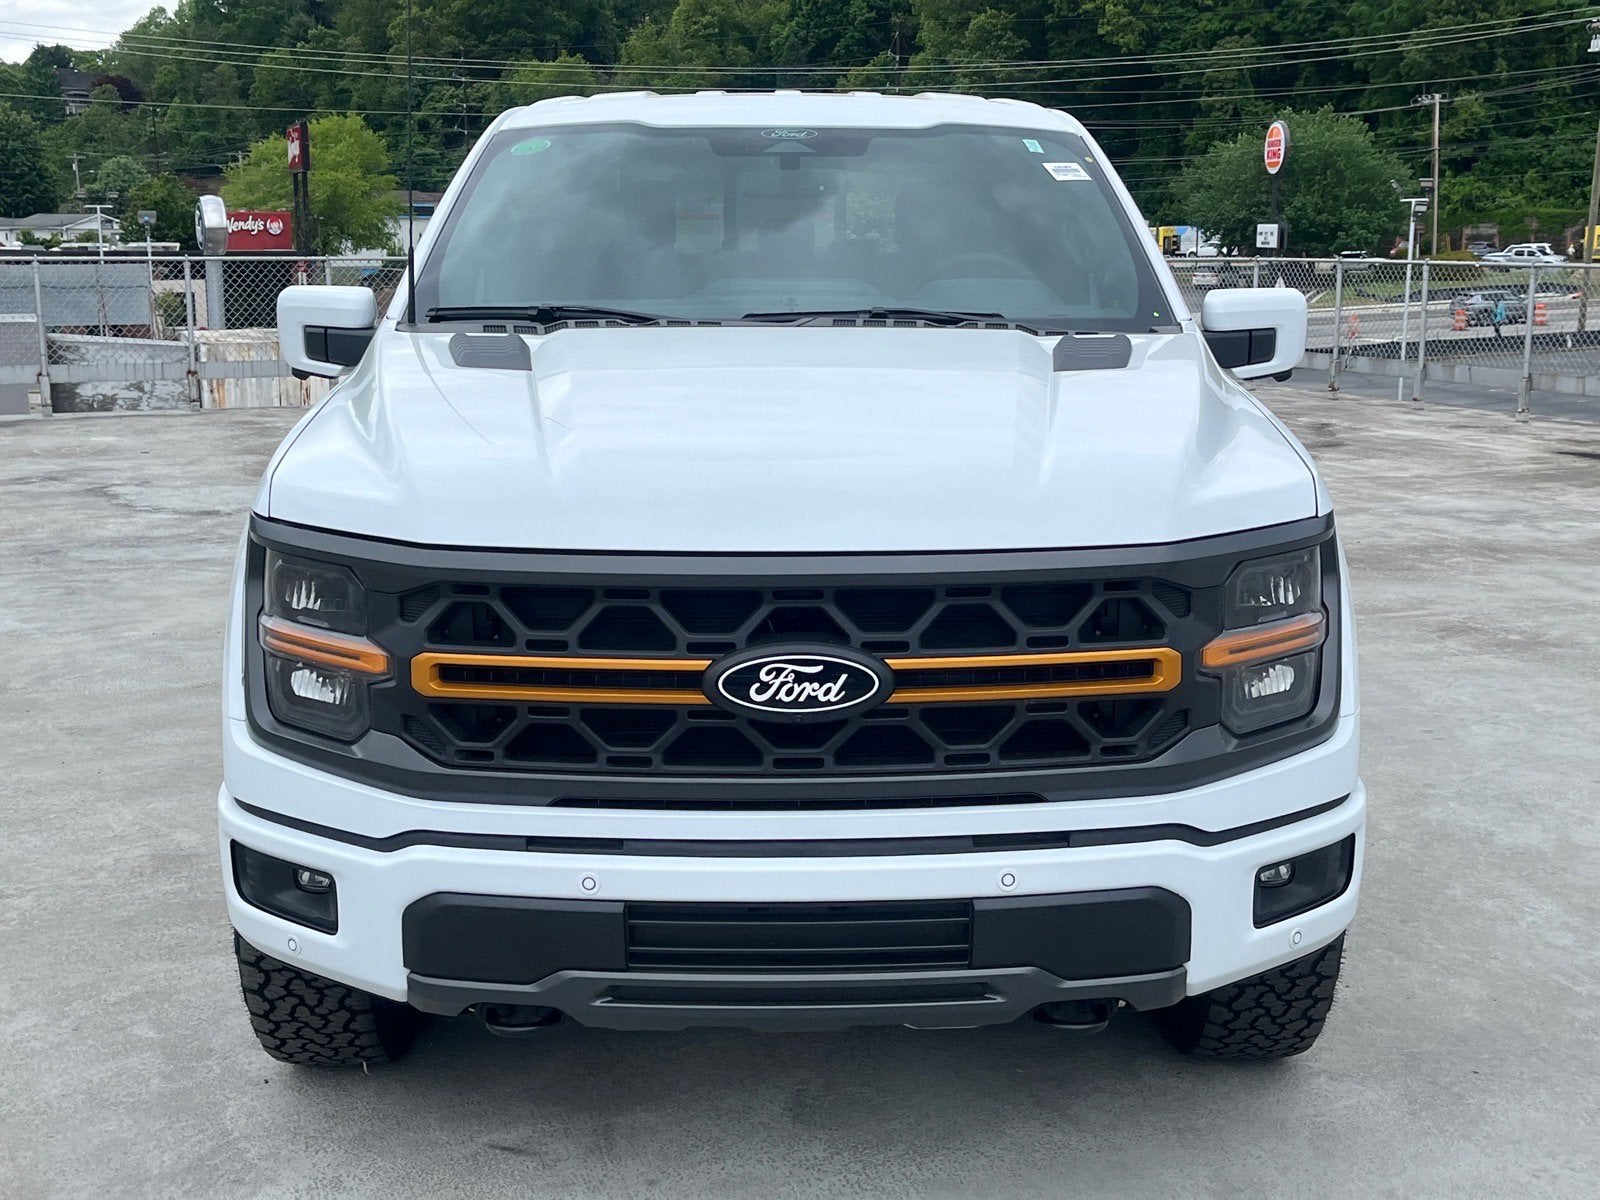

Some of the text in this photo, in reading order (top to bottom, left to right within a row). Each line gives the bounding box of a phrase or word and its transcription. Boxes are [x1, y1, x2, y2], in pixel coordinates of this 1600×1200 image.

[771, 129, 807, 138] Ford
[1267, 148, 1281, 160] KING
[750, 663, 848, 702] Ford
